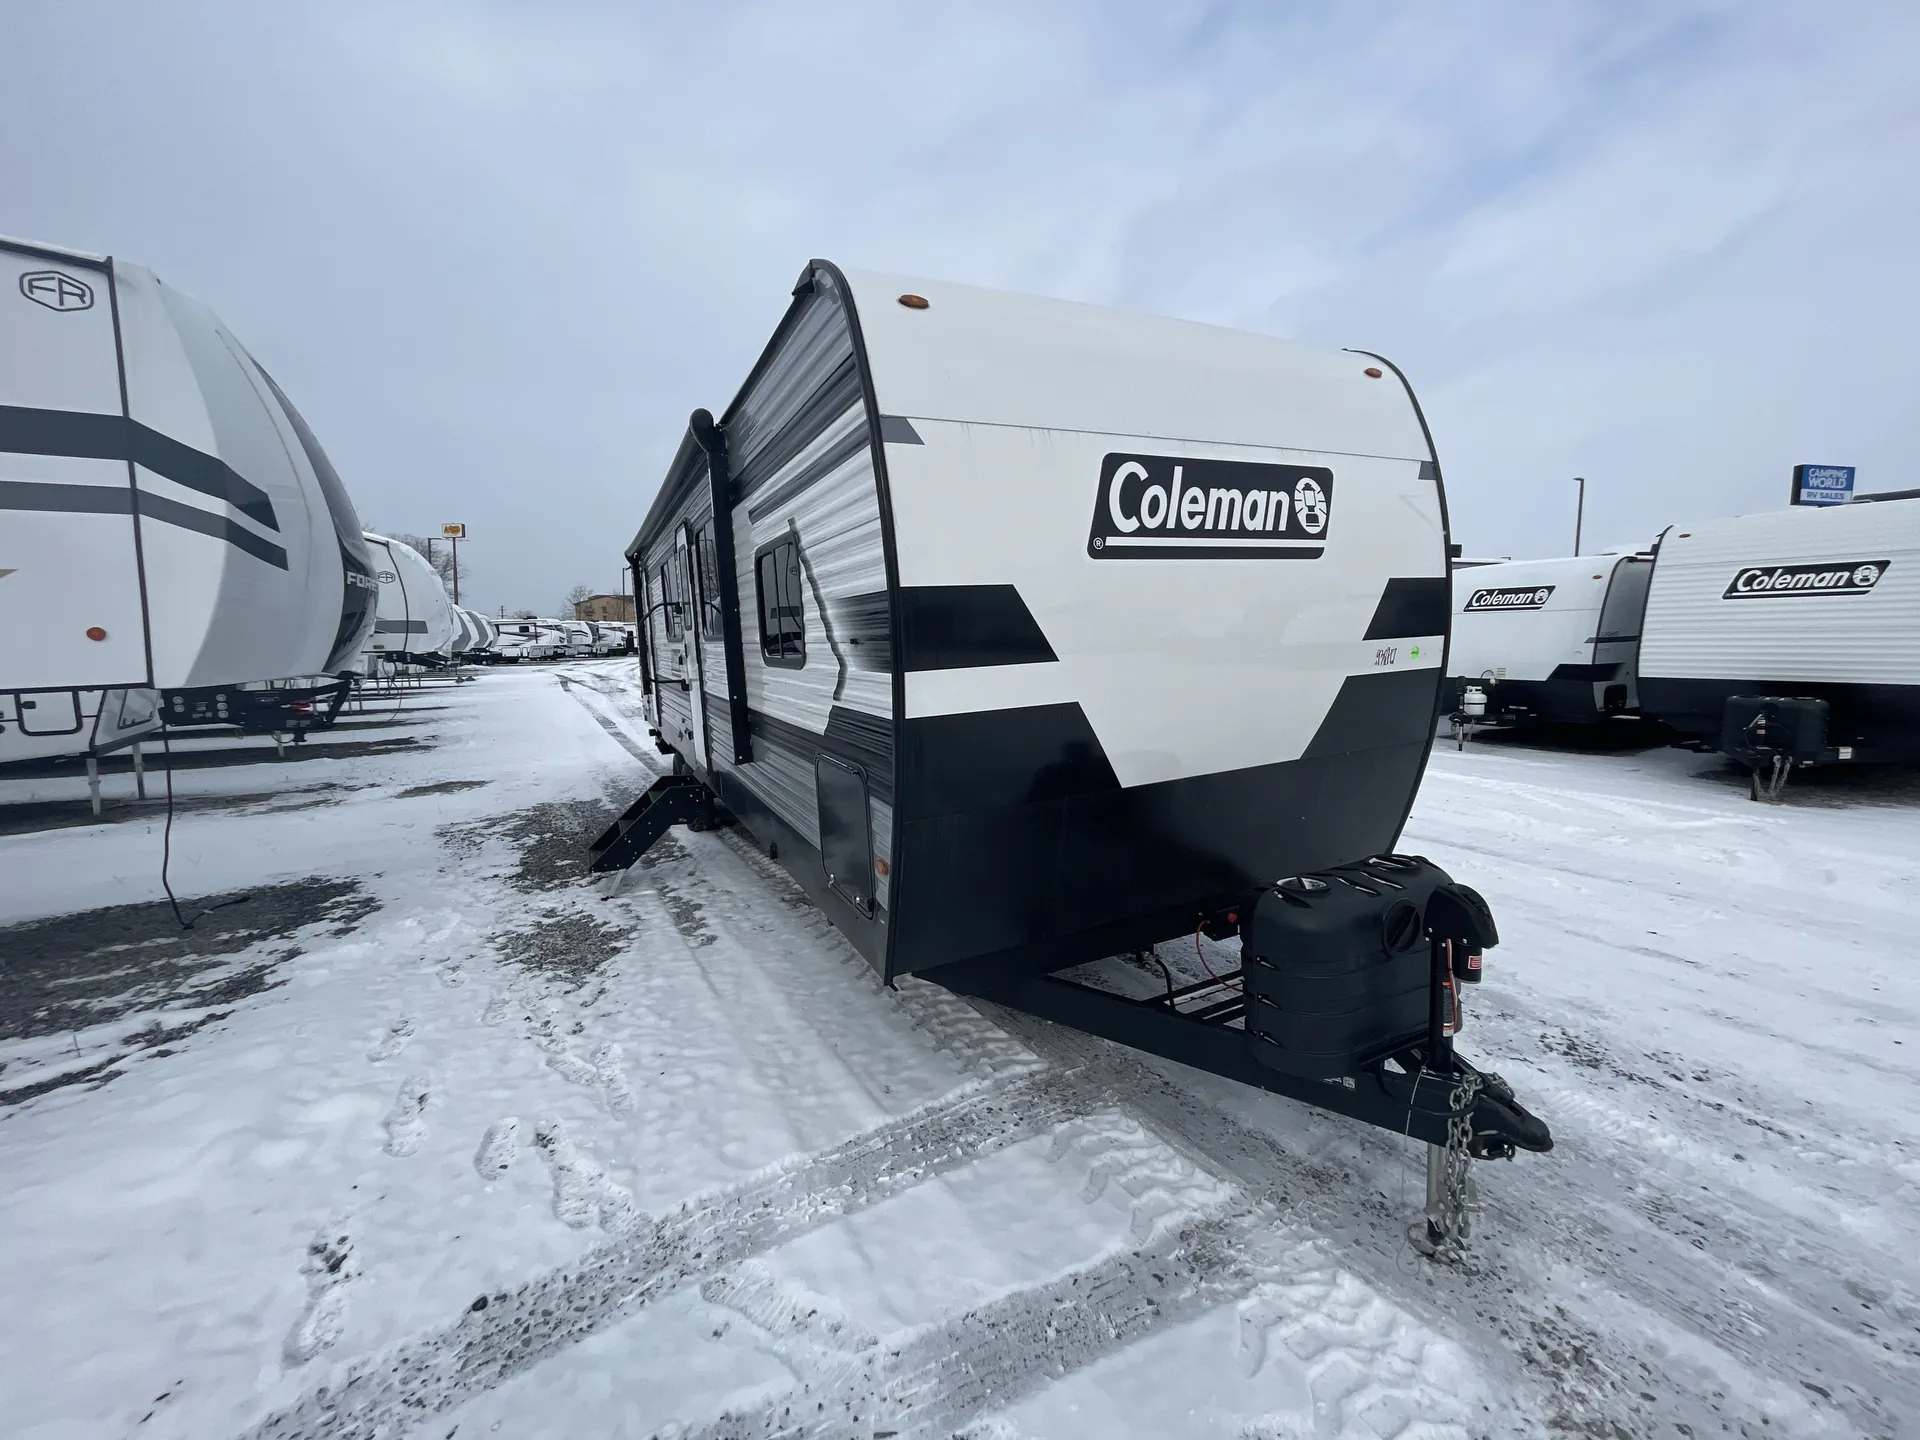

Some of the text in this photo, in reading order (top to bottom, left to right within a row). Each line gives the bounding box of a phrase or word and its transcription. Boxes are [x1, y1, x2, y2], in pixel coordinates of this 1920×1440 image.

[1809, 468, 1848, 479] CAMPING
[1808, 477, 1847, 489] WORLD
[1108, 460, 1290, 534] Coleman
[1807, 491, 1845, 500] RV SALES
[1736, 568, 1851, 592] Coleman
[1471, 590, 1534, 607] Coleman
